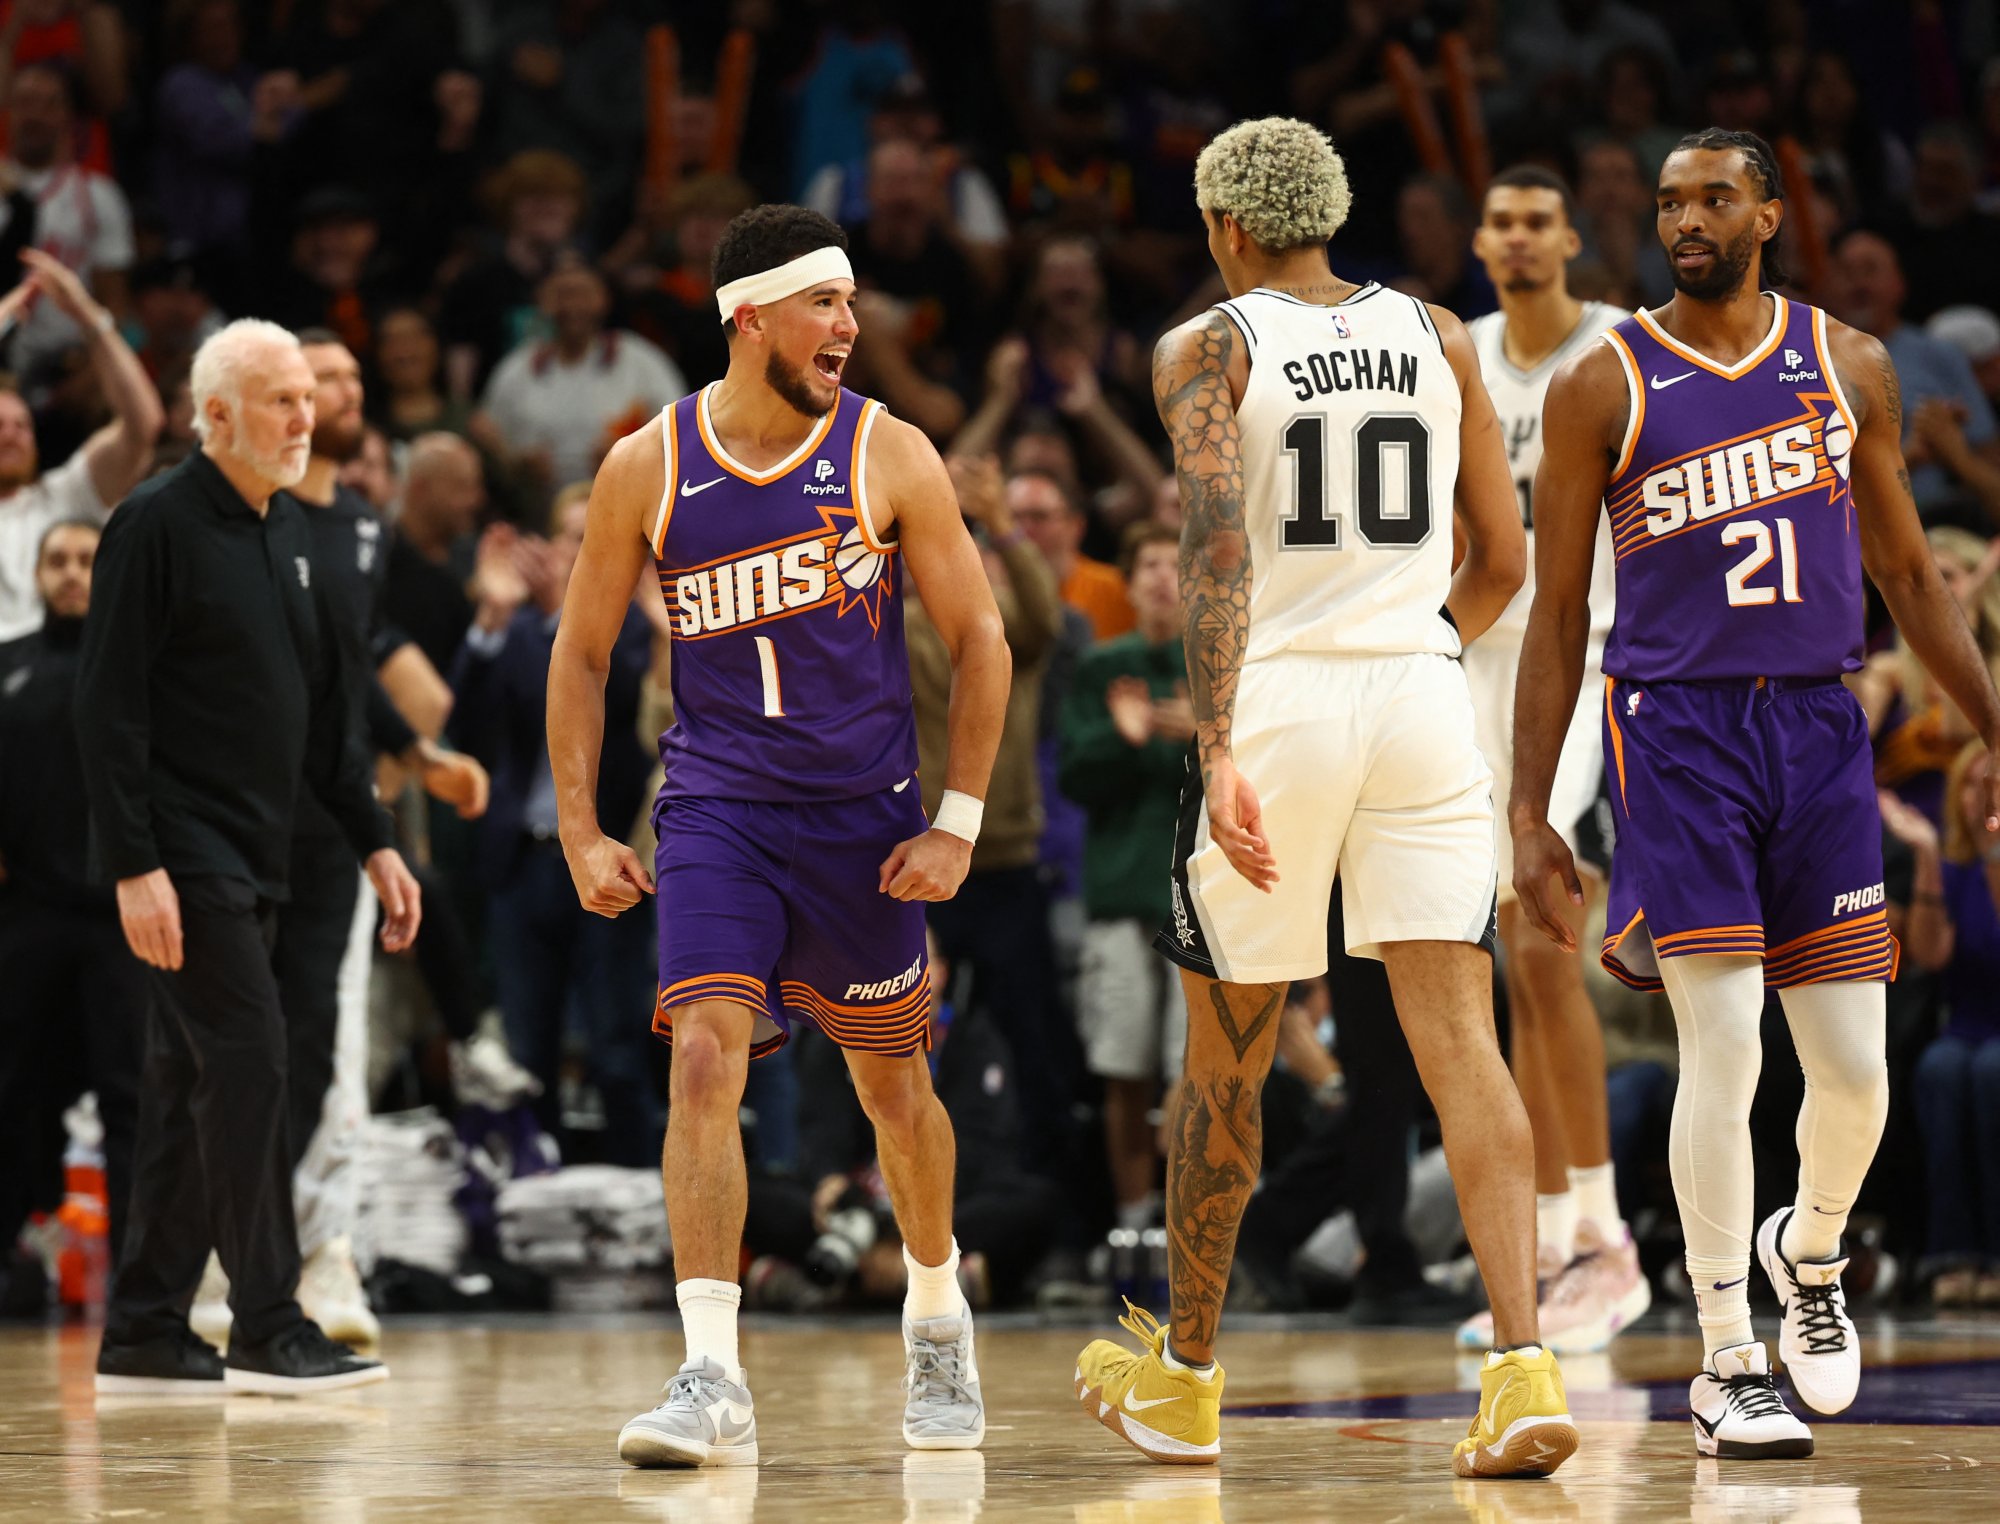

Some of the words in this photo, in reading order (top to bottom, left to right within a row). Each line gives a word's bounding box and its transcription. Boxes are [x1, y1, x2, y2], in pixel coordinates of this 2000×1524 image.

[1283, 349, 1418, 401] SOCHAN
[1778, 370, 1818, 382] PayPal
[803, 484, 845, 496] PayPal
[1278, 411, 1434, 552] 10
[1642, 424, 1816, 537] SUNS
[677, 540, 827, 636] SUNS
[1721, 517, 1804, 607] 21
[754, 636, 786, 717] 1
[843, 953, 921, 1000] PHOENIX
